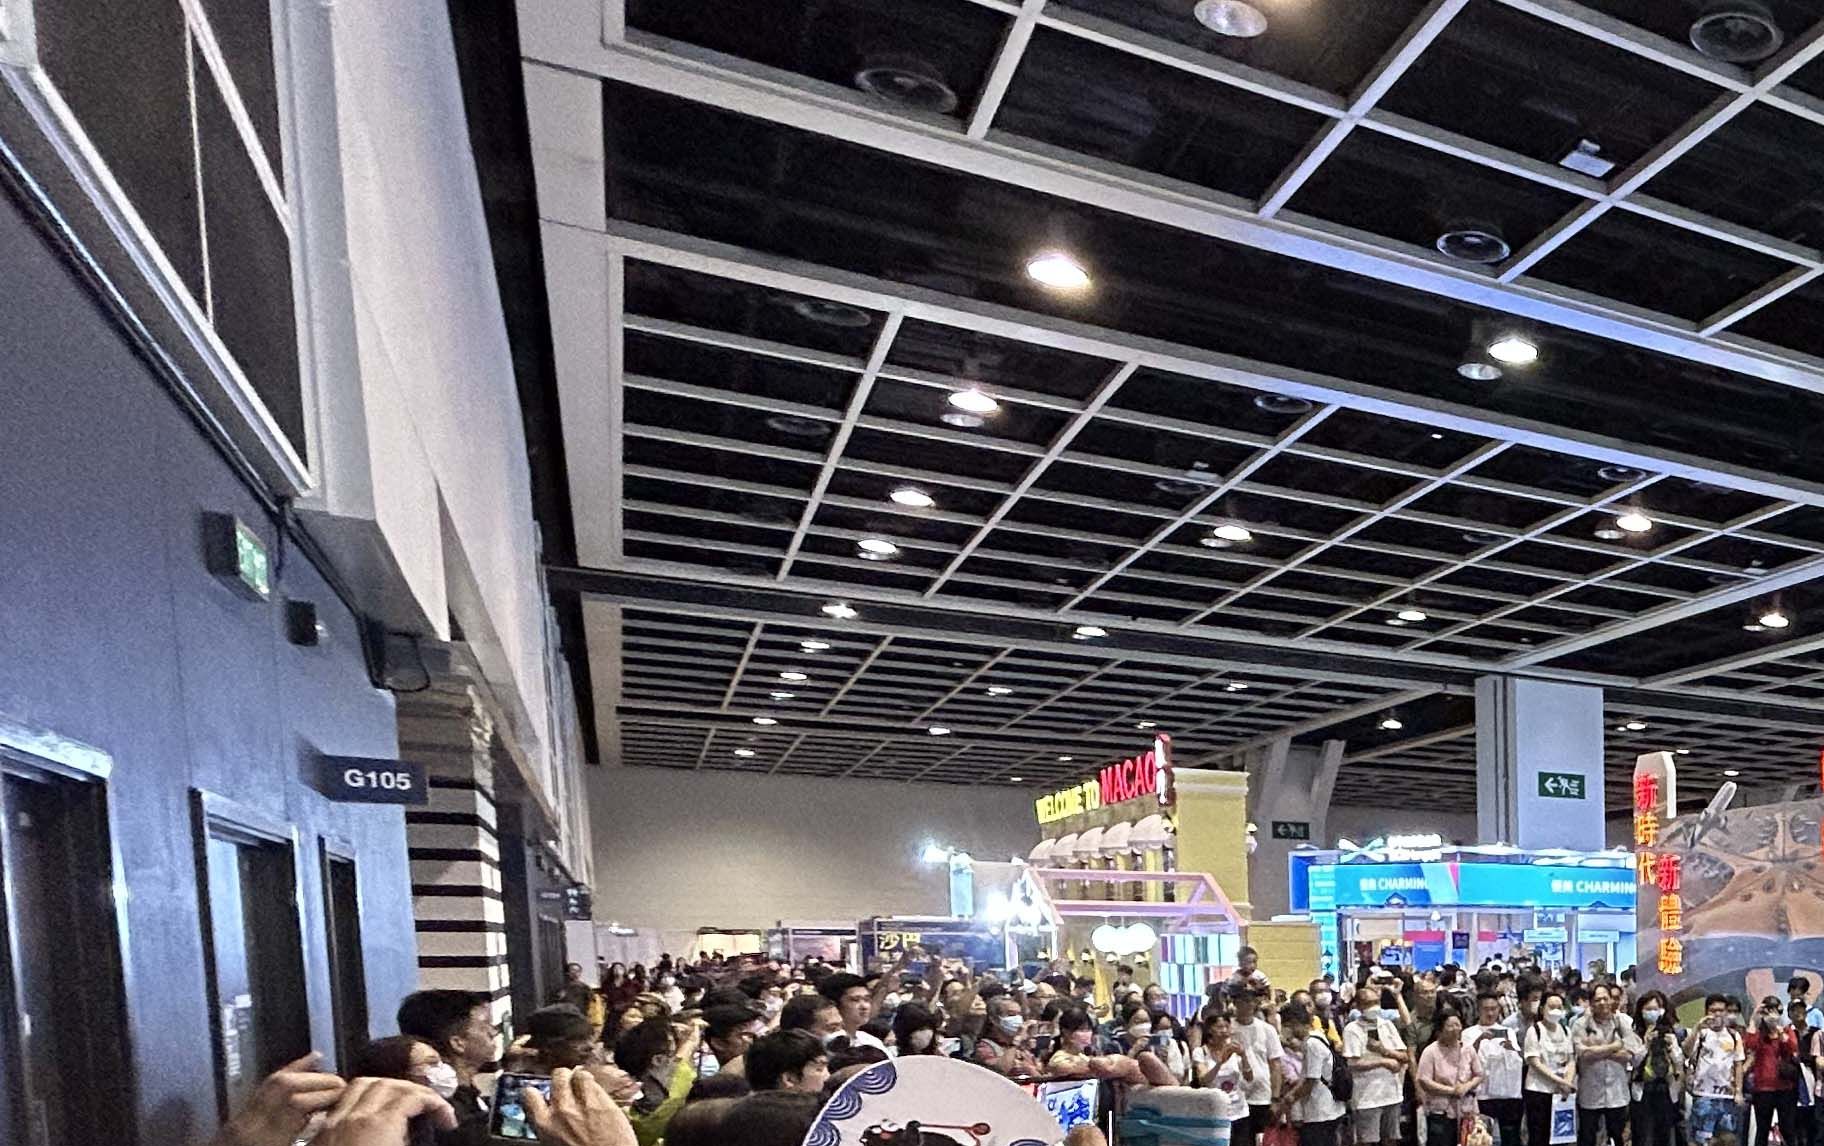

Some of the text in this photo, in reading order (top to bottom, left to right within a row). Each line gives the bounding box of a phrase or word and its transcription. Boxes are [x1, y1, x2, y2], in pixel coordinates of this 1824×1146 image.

[344, 769, 412, 790] G105
[1035, 751, 1156, 825] WELCOME TO MACAO
[1634, 773, 1660, 885] 新時代
[1658, 854, 1683, 975] 新體驗
